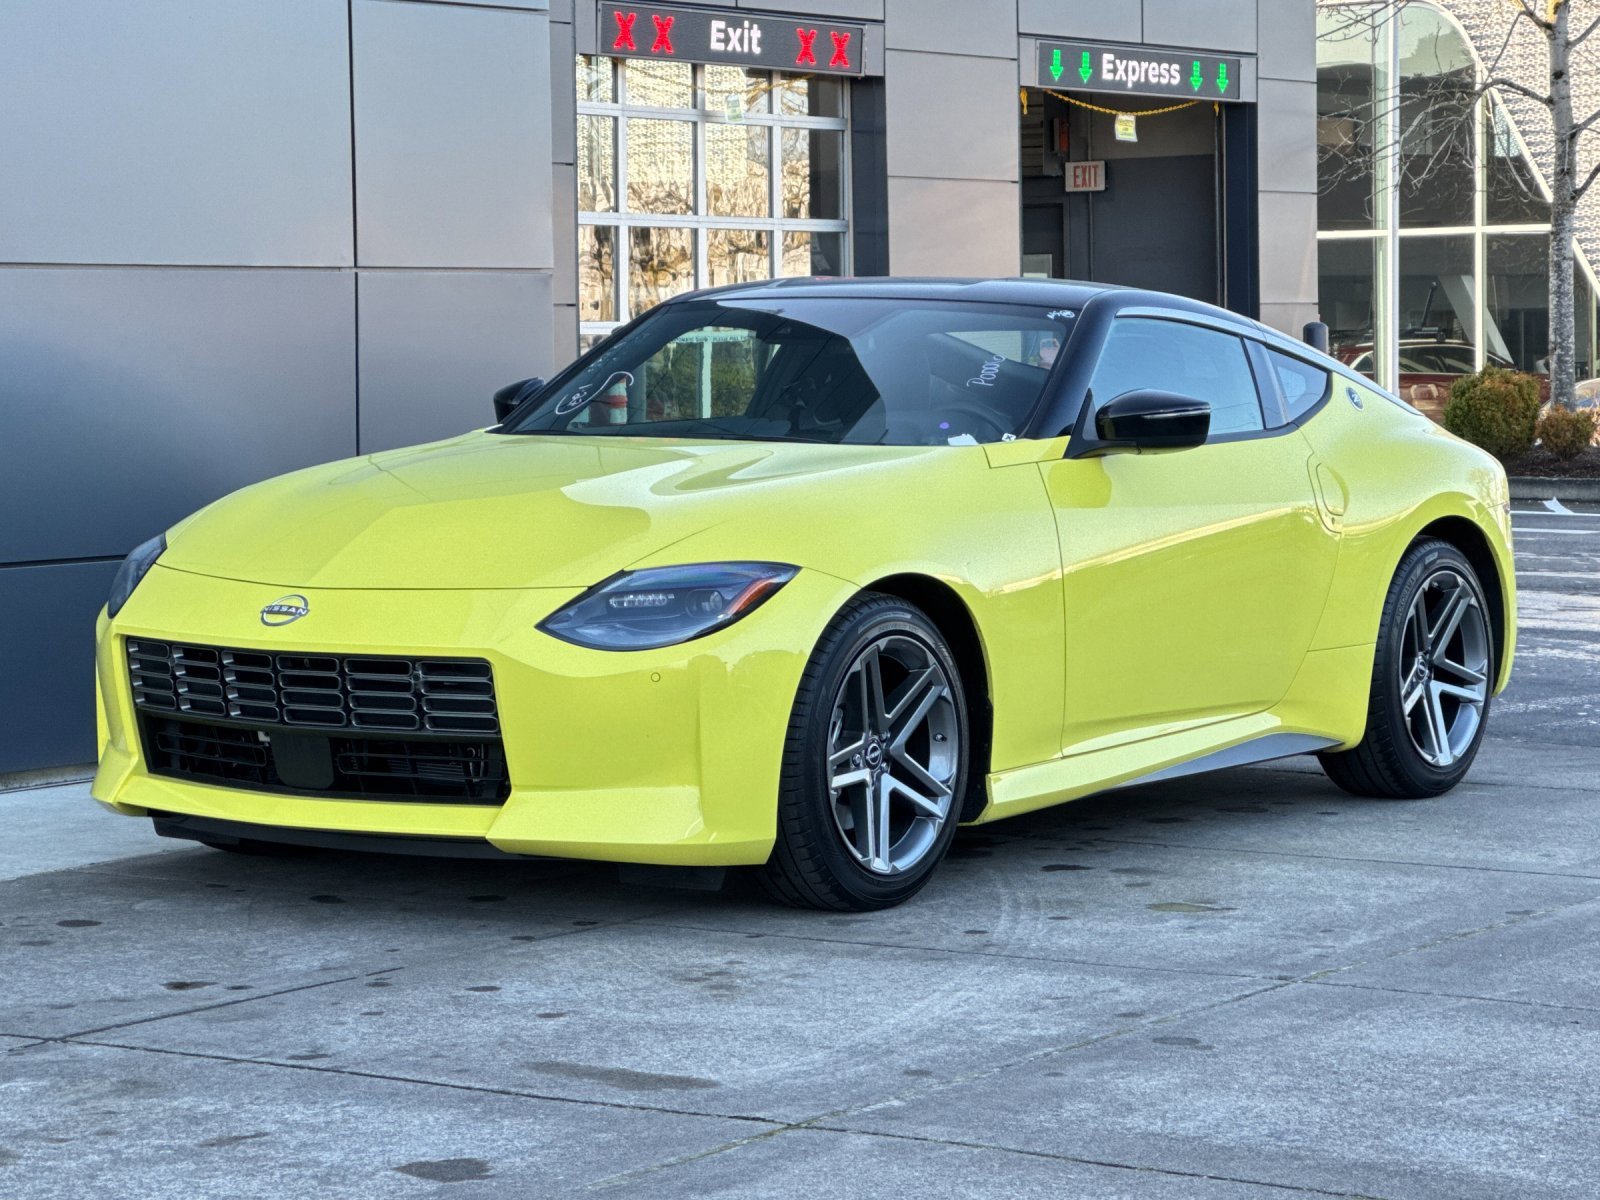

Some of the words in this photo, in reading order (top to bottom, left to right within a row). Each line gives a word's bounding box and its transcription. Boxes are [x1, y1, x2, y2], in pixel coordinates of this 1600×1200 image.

[711, 20, 762, 54] Exit
[1102, 53, 1181, 88] Express
[1073, 165, 1099, 188] EXIT
[263, 604, 308, 615] NISSAN
